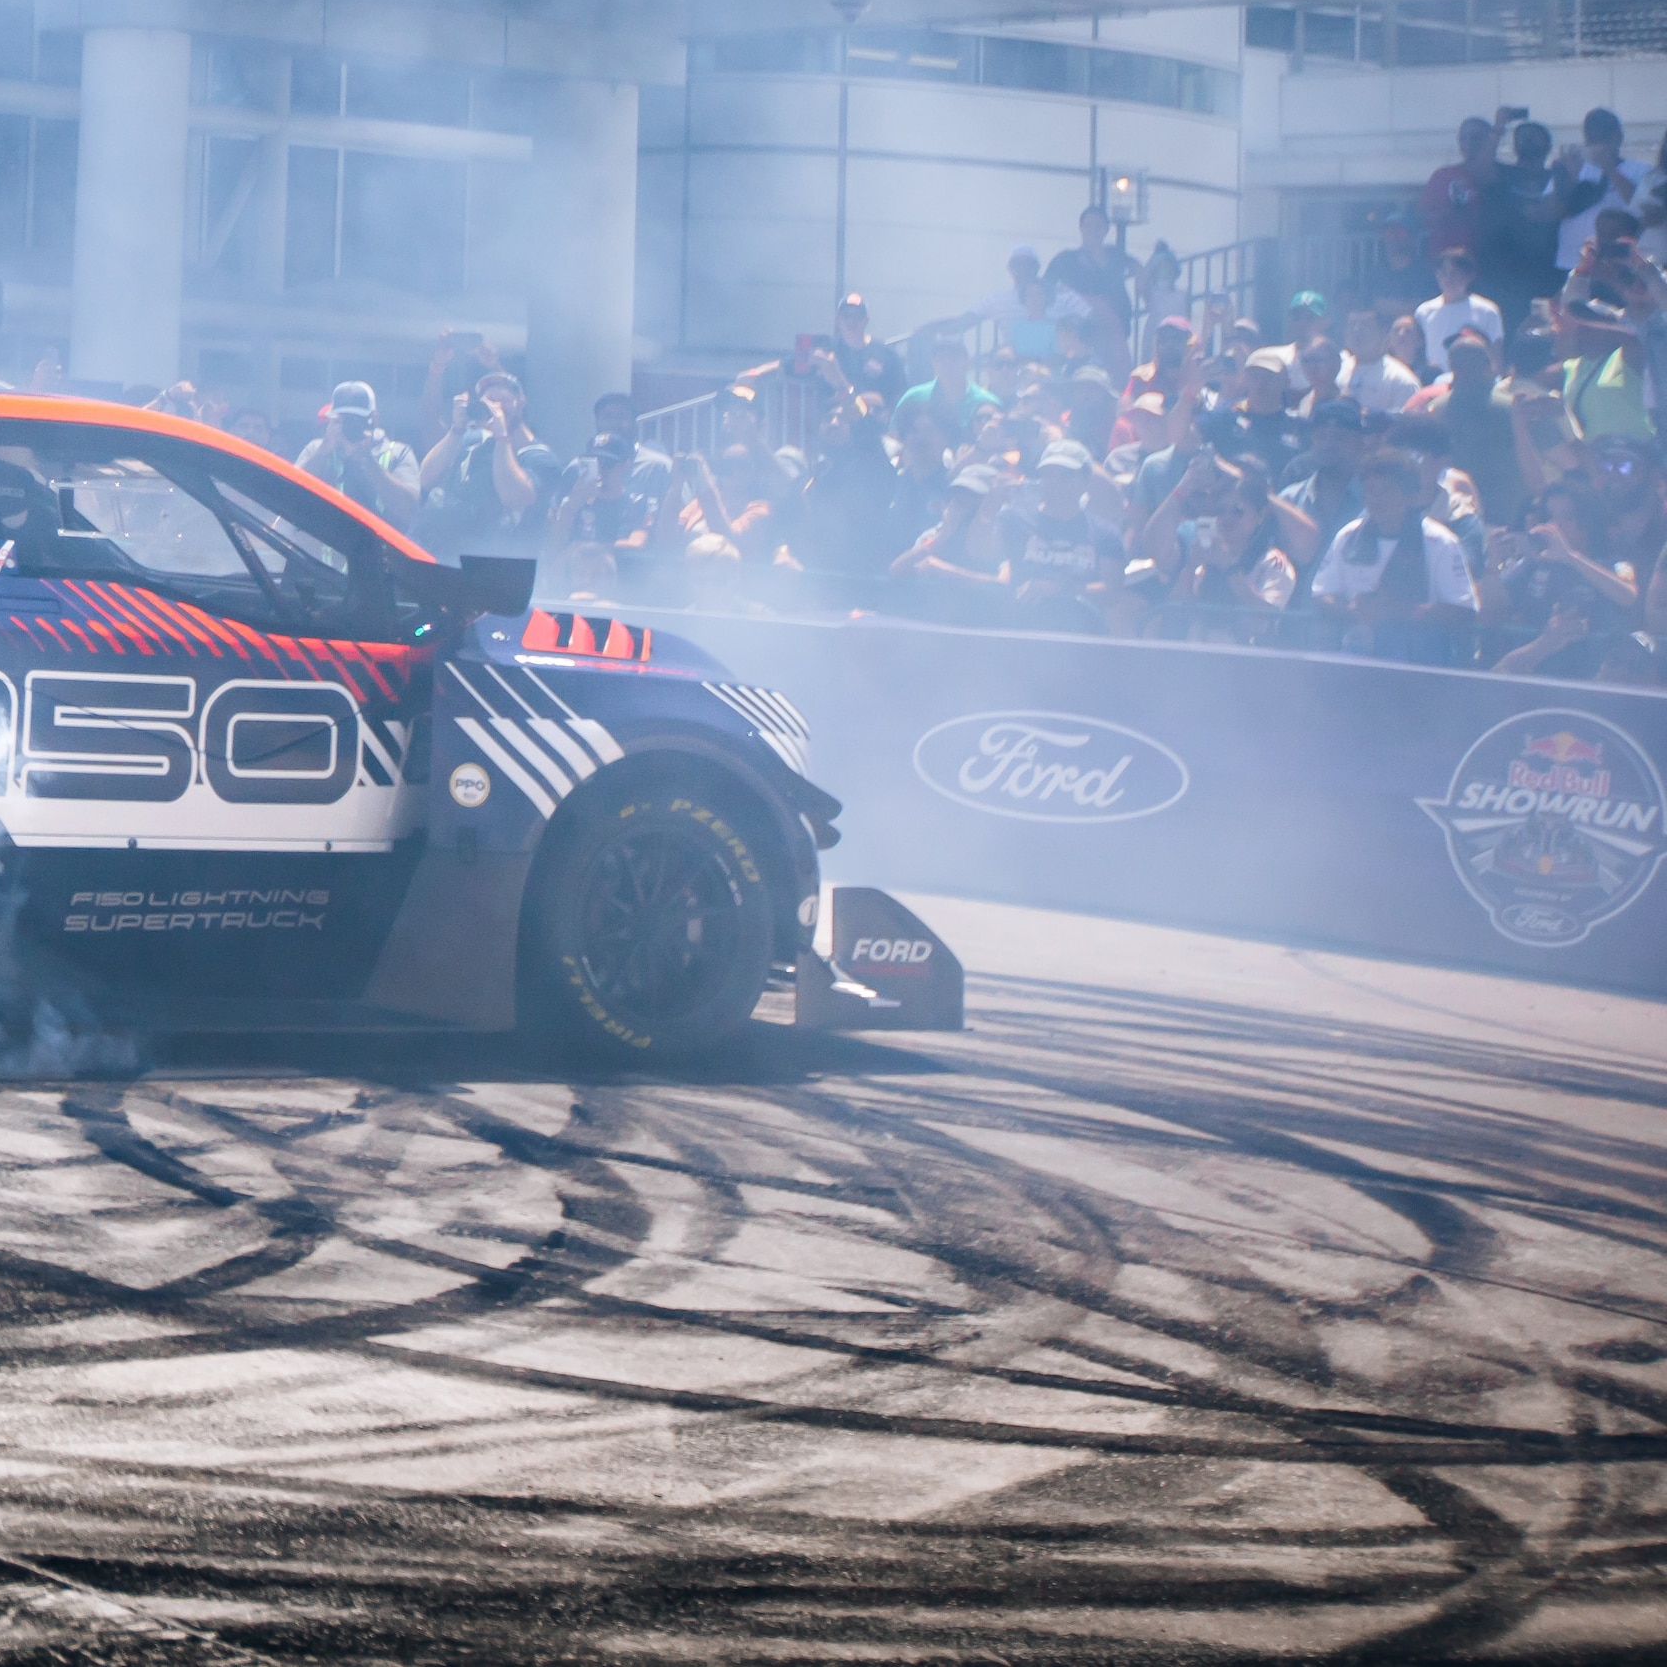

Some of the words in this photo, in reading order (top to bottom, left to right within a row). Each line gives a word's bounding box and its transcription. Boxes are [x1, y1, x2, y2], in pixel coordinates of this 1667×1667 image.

[958, 722, 1134, 808] Ford
[1508, 759, 1557, 791] Red
[1559, 765, 1611, 798] Bull
[1456, 781, 1660, 833] SHOWRUN
[70, 890, 144, 908] F150
[148, 889, 331, 908] LIGHTNING
[63, 910, 329, 933] SUPERTRUCK
[852, 937, 933, 963] FORD
